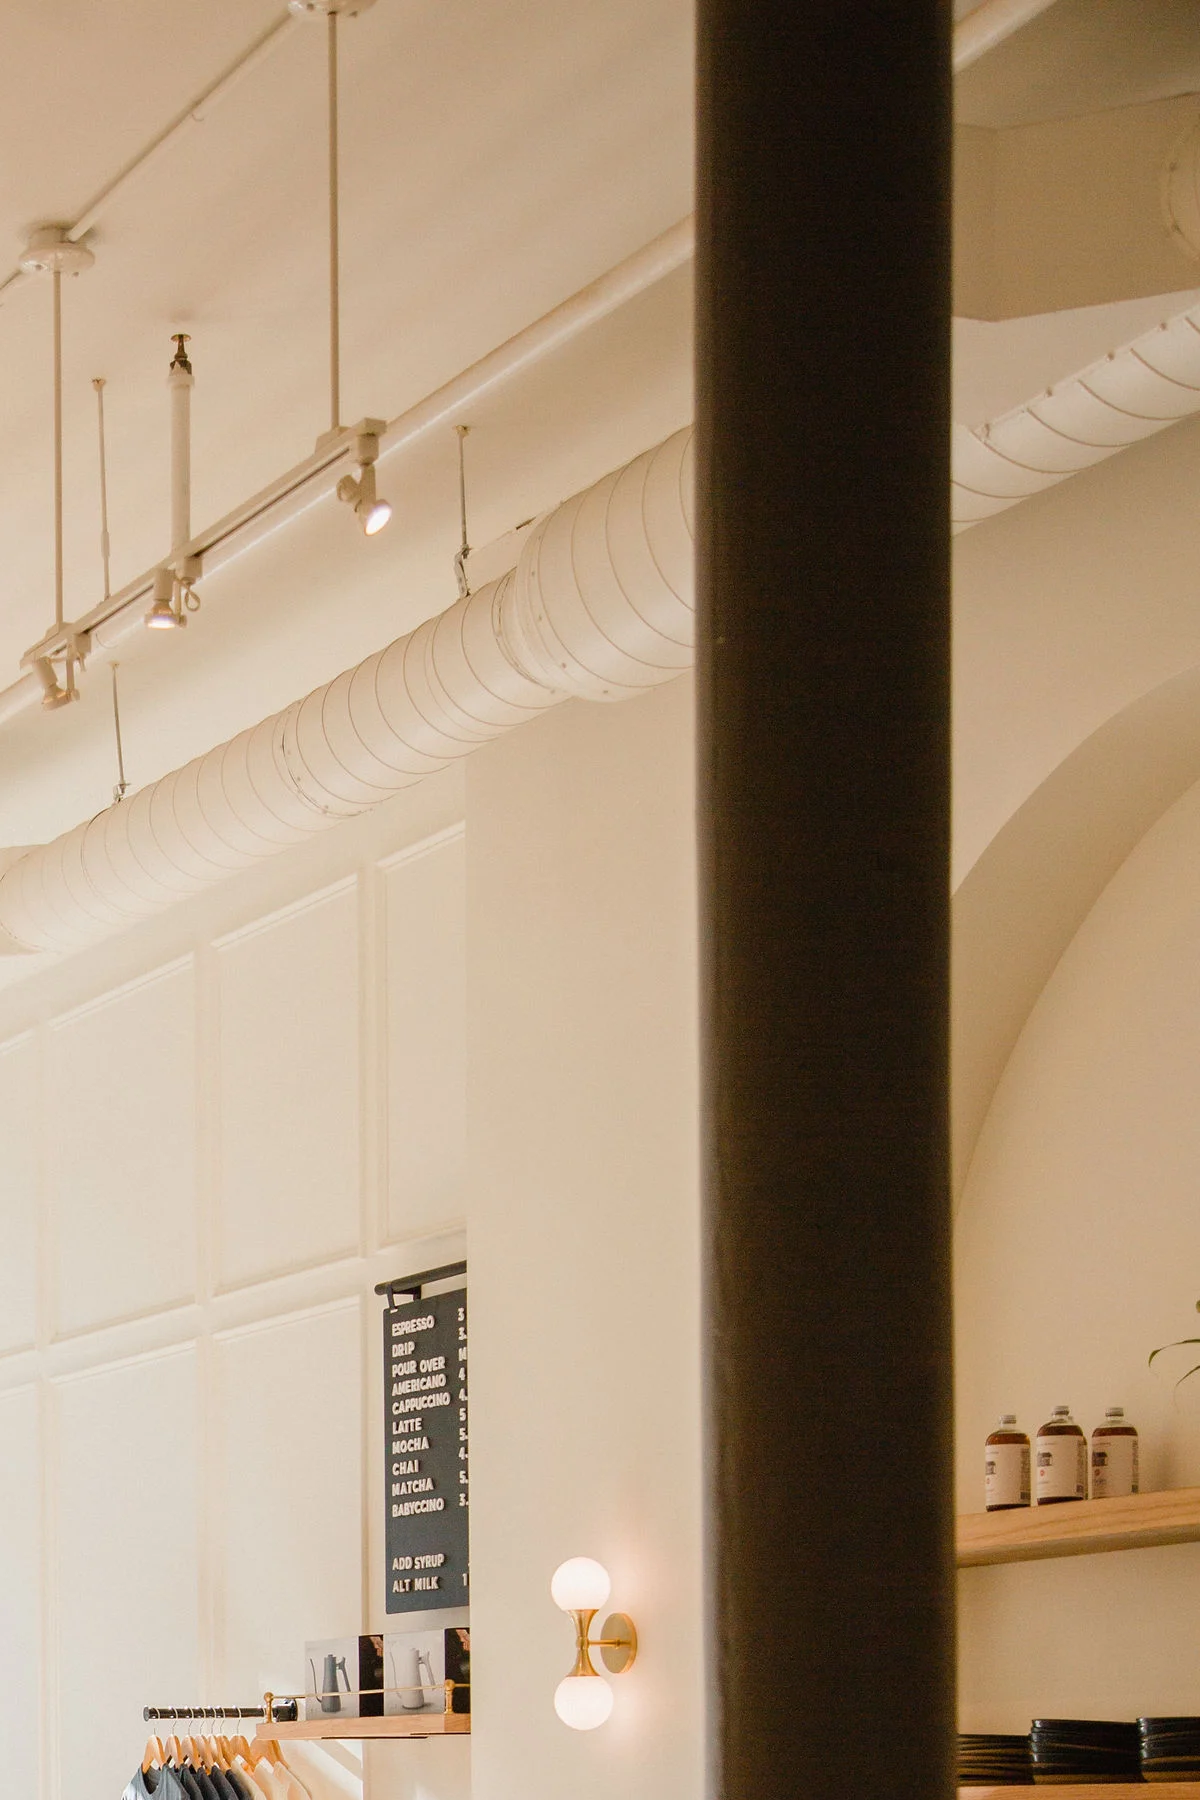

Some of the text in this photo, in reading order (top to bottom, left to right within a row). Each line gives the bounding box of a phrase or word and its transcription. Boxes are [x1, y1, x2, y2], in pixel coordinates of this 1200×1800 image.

[392, 1315, 435, 1337] ESPRESSO
[392, 1341, 415, 1358] DRIP
[392, 1360, 417, 1378] POUR
[419, 1356, 445, 1373] OVER
[392, 1373, 447, 1397] AMERICANO
[392, 1392, 451, 1415] CAPPUCCINO
[392, 1417, 422, 1435] LATTE
[392, 1436, 430, 1455] MOCHA
[392, 1459, 419, 1476] CHAI
[392, 1477, 434, 1497] MATCHA
[392, 1497, 445, 1518] BABYCCINO
[392, 1553, 445, 1571] ADD SYRUP
[392, 1579, 410, 1594] ALT
[414, 1576, 440, 1591] MILK
